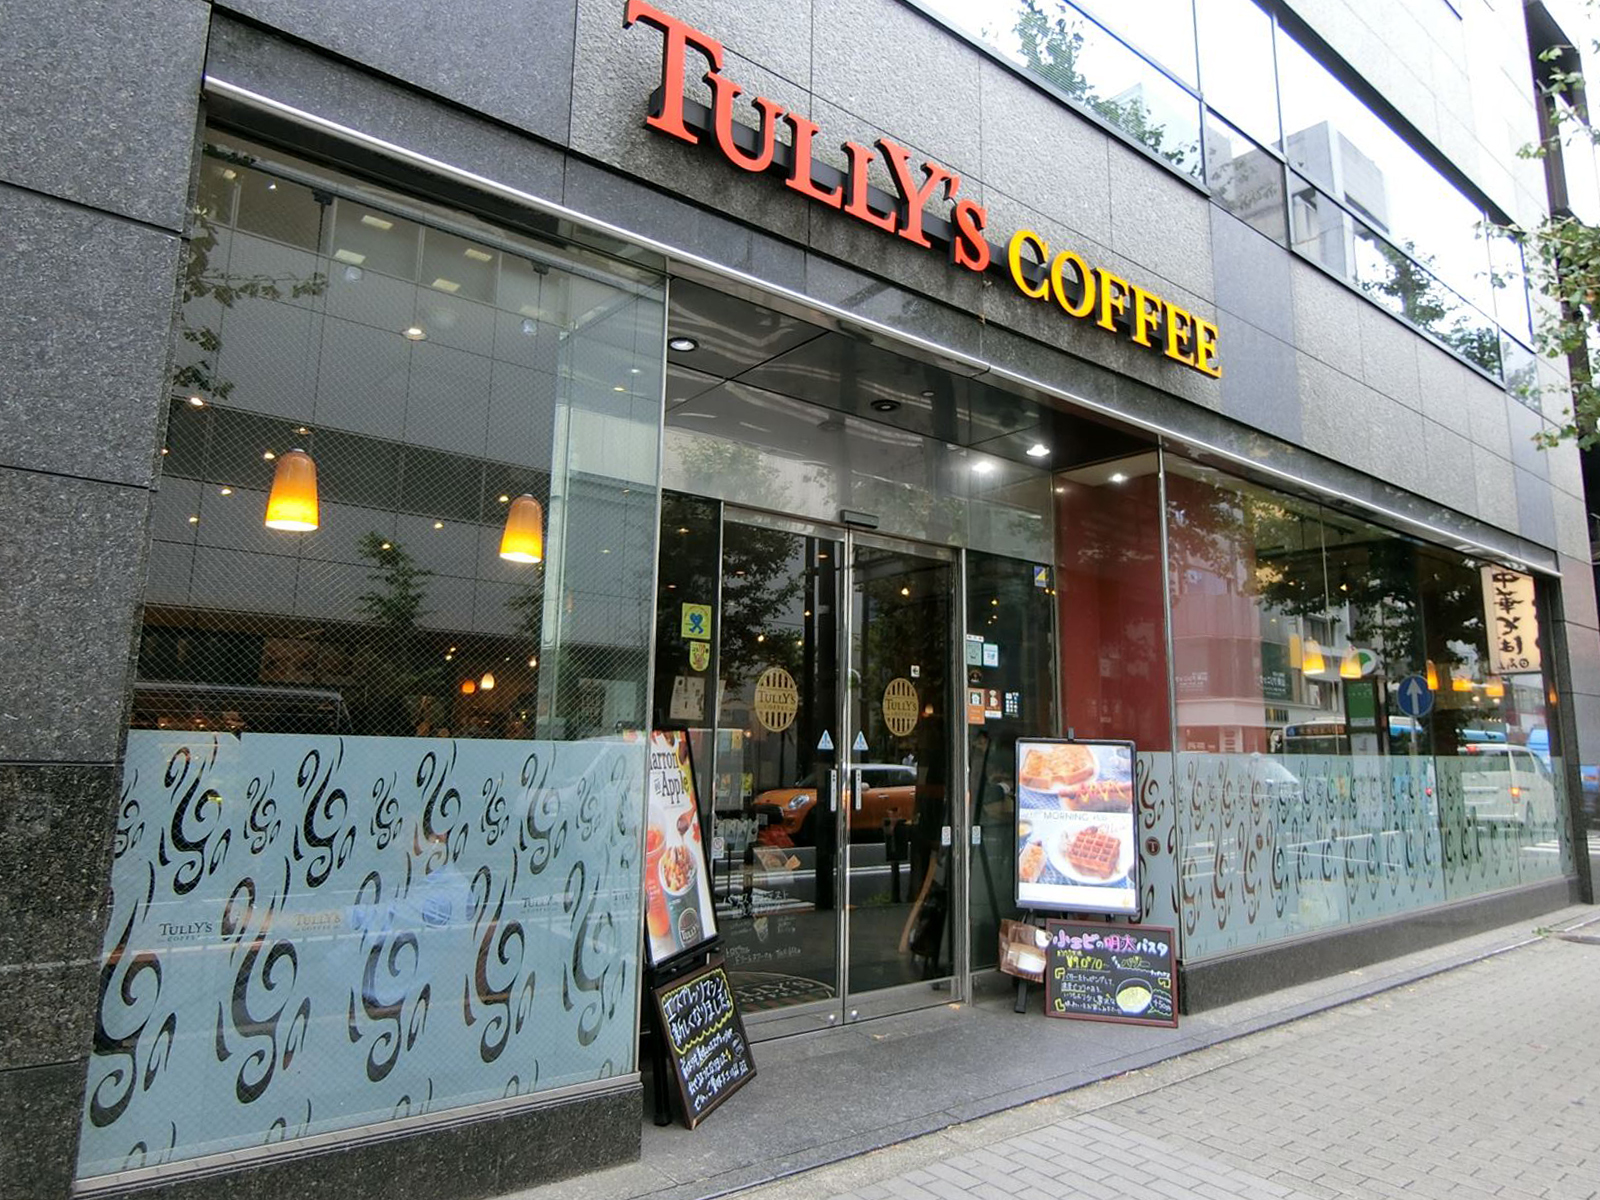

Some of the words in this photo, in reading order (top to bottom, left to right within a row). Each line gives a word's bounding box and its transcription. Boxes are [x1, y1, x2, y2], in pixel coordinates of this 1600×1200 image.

[623, 0, 991, 272] TULLY'S
[1007, 229, 1223, 379] COFFEE
[757, 690, 796, 705] TULLY'S
[885, 698, 917, 712] TULLY'S
[651, 752, 679, 770] arron
[662, 770, 690, 804] Apple
[1043, 811, 1089, 821] MORNING
[158, 921, 213, 936] TULLY'S
[1052, 929, 1168, 957] 小エビの明太パスタ
